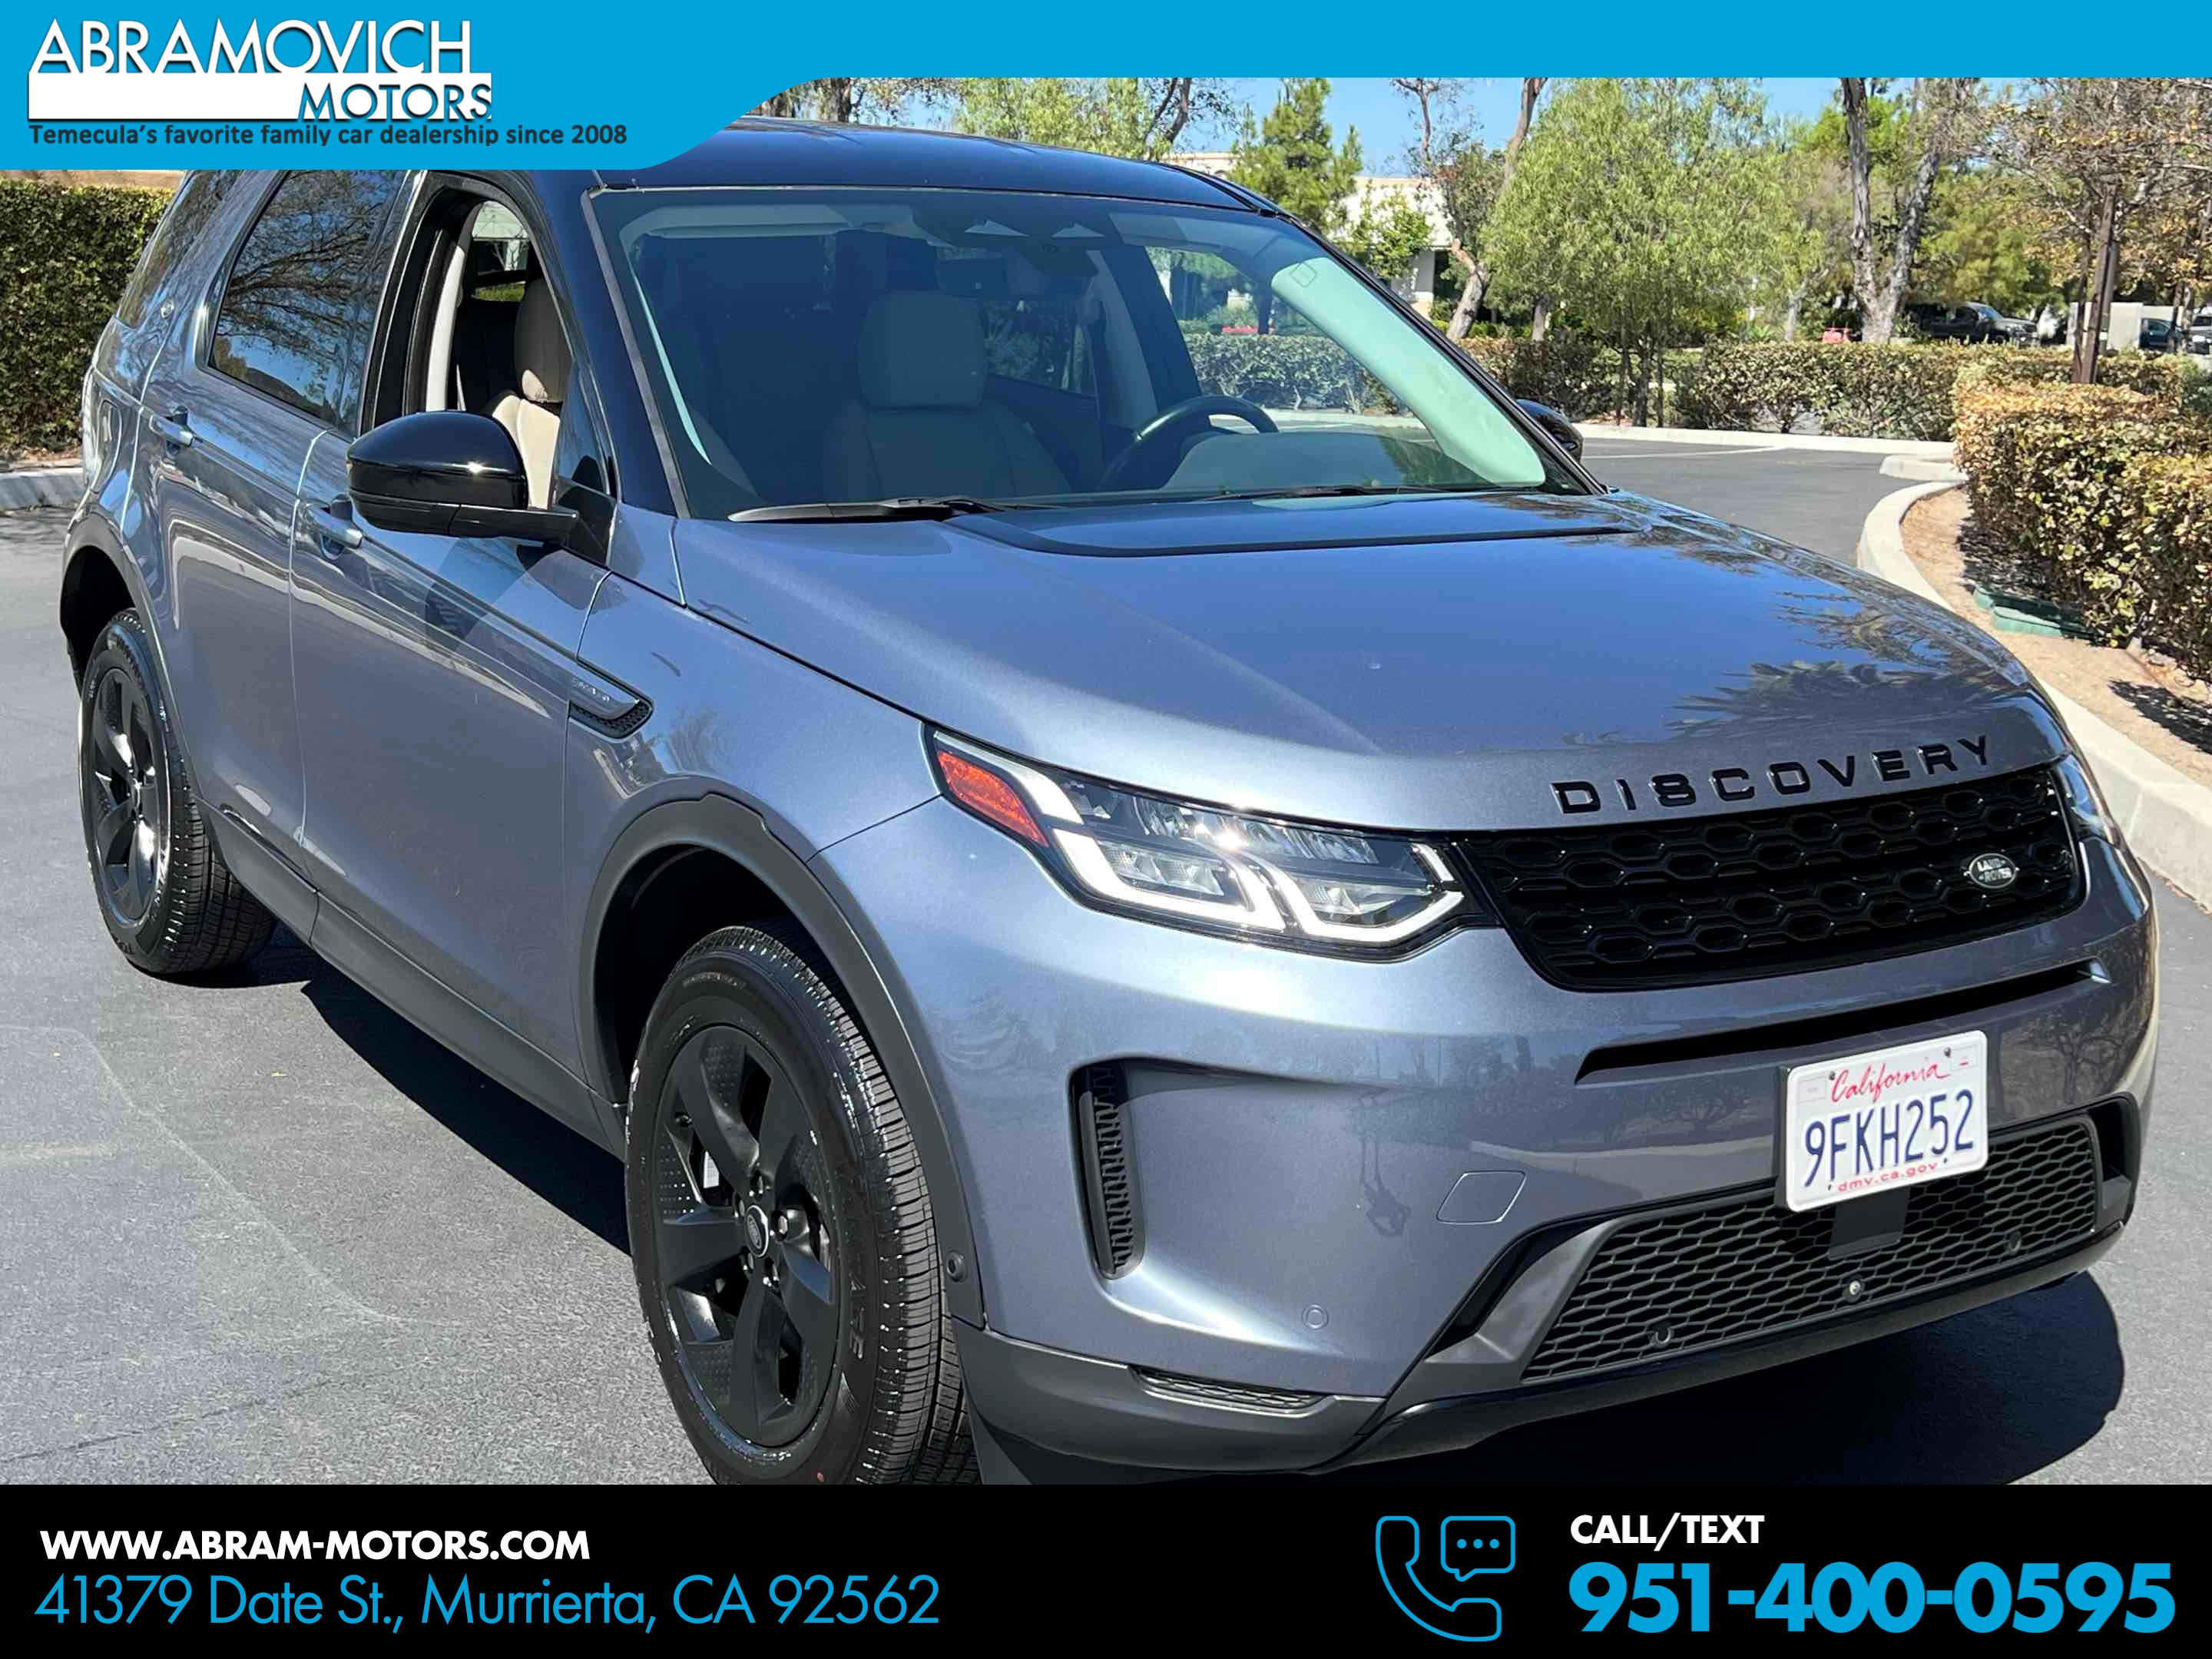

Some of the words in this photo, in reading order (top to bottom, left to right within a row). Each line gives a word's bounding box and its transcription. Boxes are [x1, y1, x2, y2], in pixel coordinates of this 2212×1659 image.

[1549, 735, 1987, 814] DISCOVERY
[1831, 1062, 1952, 1104] California
[1804, 1088, 1974, 1188] 9FKH252
[1837, 1161, 1939, 1193] dmv.ca.gov
